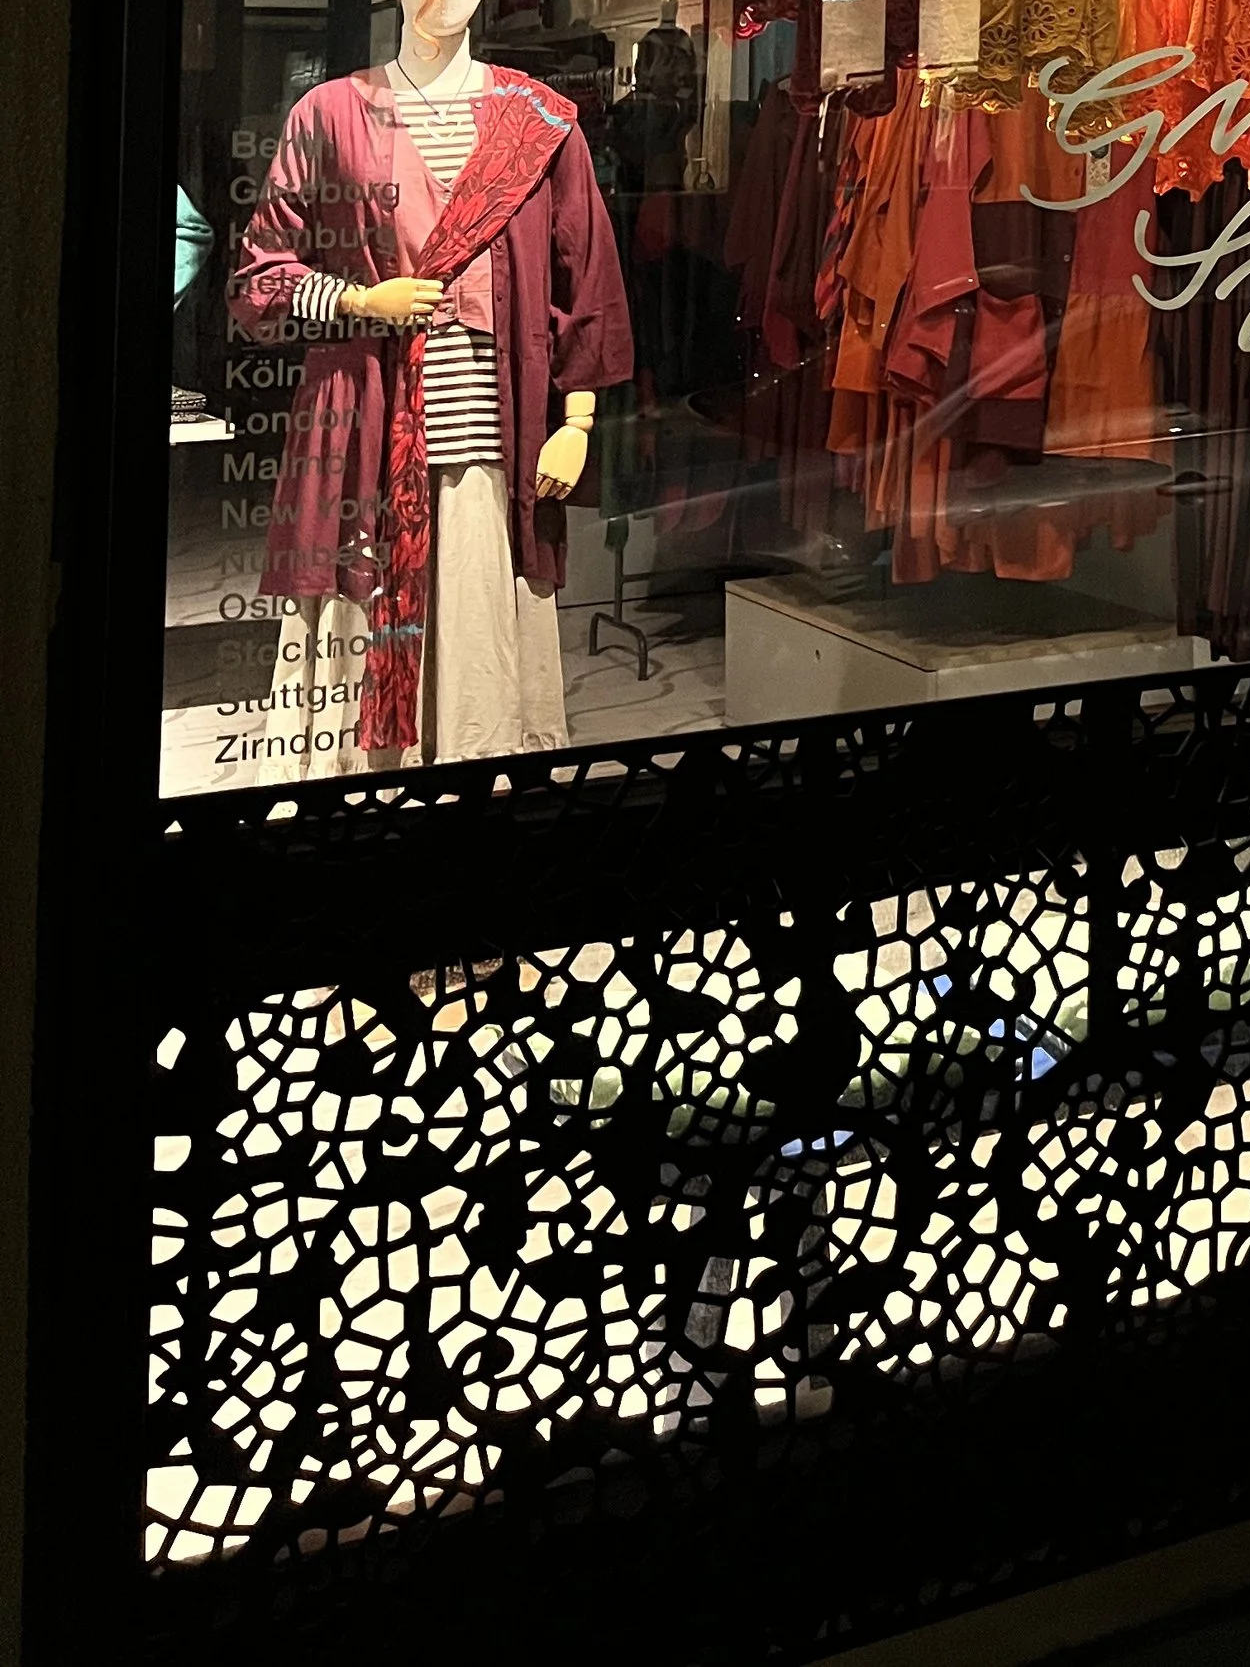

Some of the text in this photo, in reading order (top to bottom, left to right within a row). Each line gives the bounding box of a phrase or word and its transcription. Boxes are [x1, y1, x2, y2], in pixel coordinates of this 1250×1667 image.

[229, 175, 400, 212] Geborg
[225, 358, 306, 390] Köln
[224, 406, 361, 435] London
[220, 498, 300, 530] New
[219, 539, 391, 577] Nürnbeg
[218, 590, 300, 621] Oslo
[214, 630, 374, 669] Stockho
[216, 679, 367, 717] Stuttgar
[214, 718, 363, 765] Zirndorf
